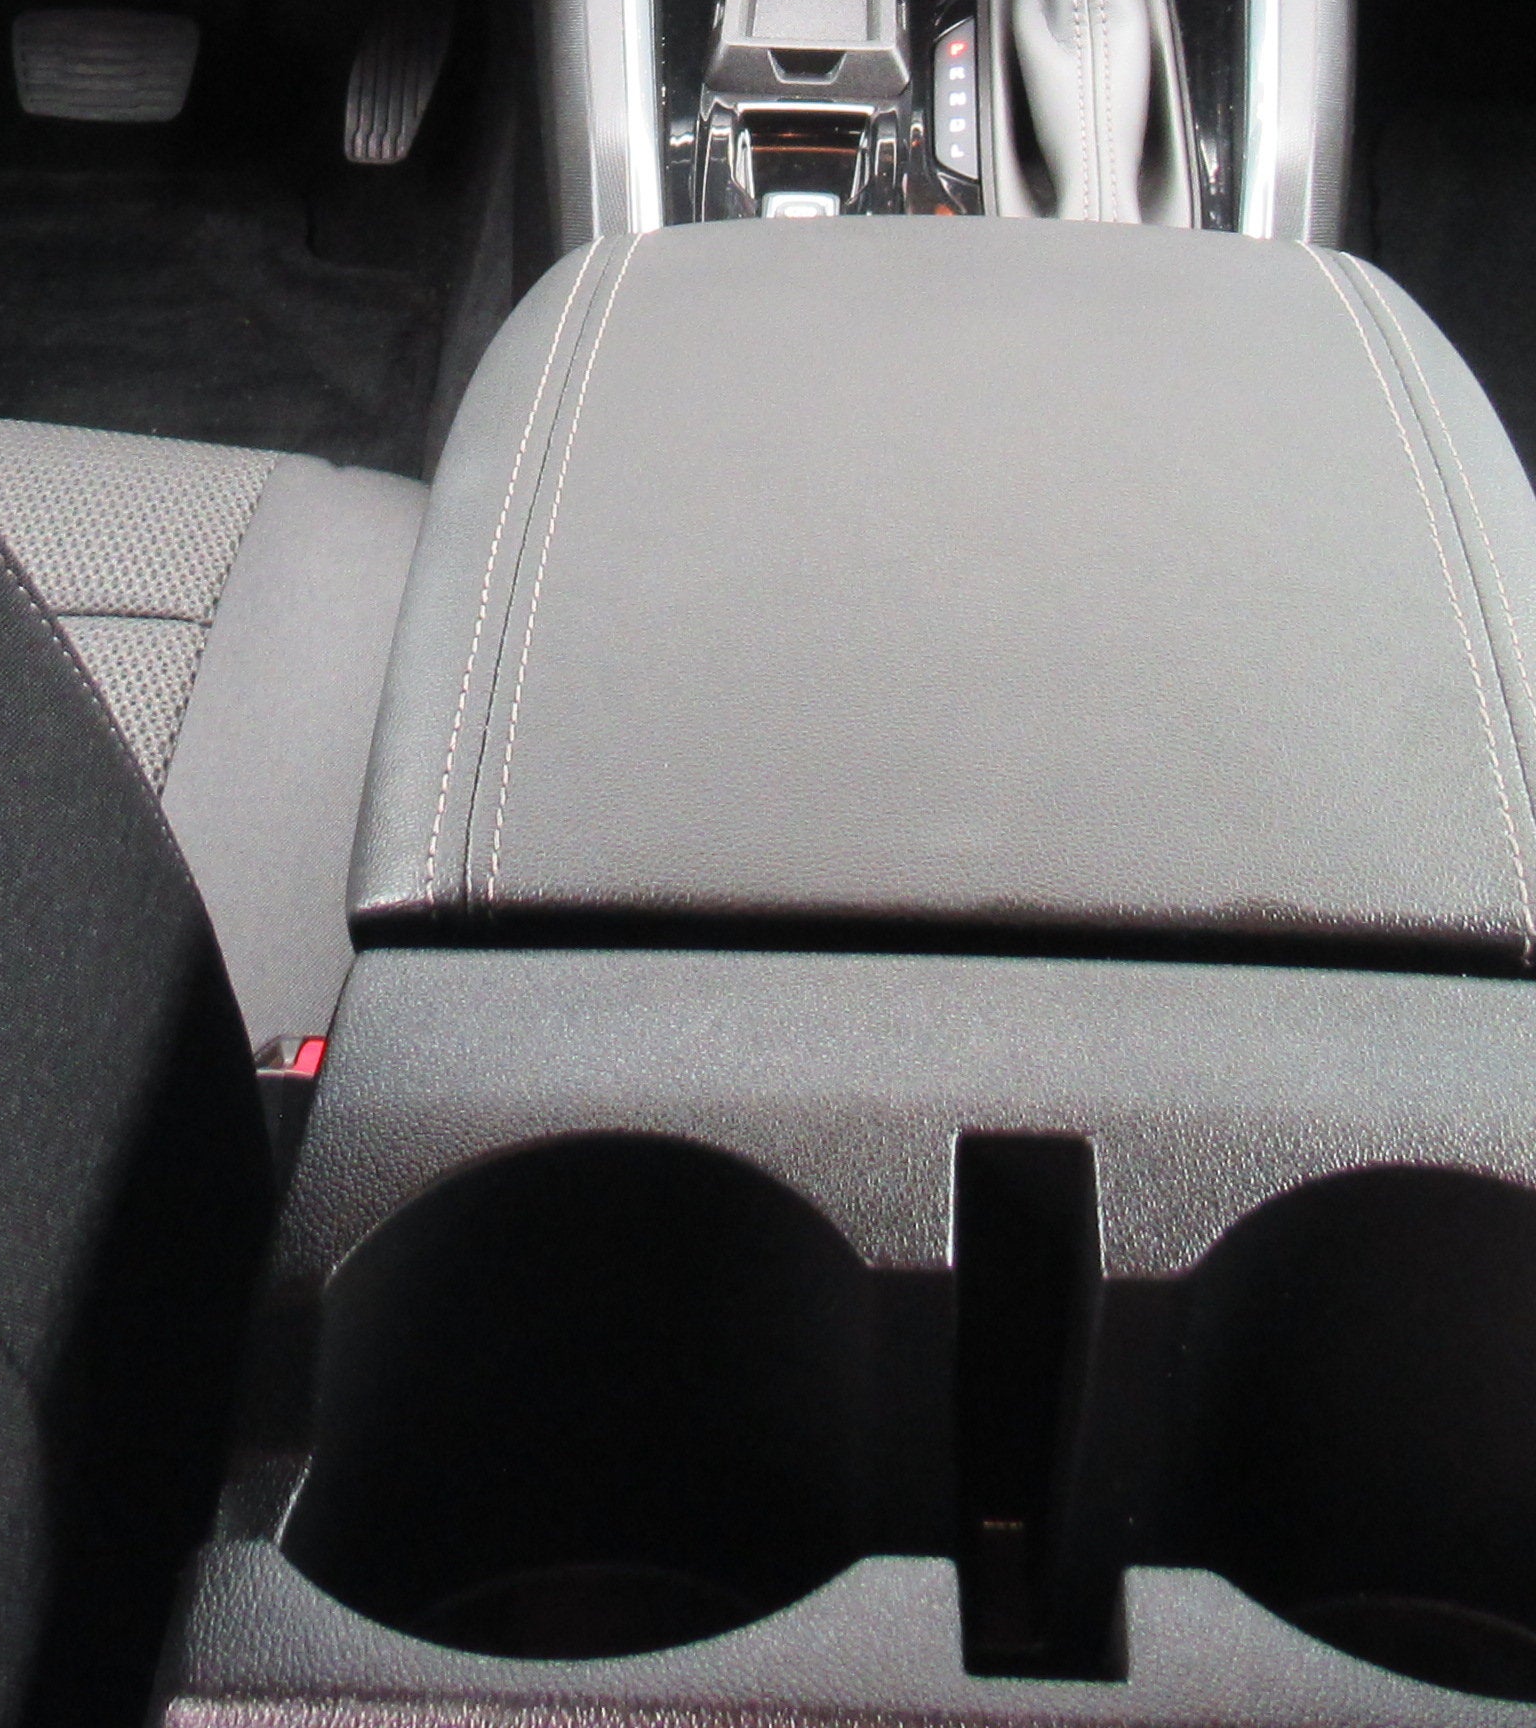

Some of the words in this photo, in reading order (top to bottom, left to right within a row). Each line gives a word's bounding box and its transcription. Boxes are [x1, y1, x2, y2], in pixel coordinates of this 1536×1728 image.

[950, 42, 964, 56] P
[949, 66, 965, 80] R
[949, 92, 966, 106] N
[949, 118, 966, 132] D
[950, 144, 964, 158] L
